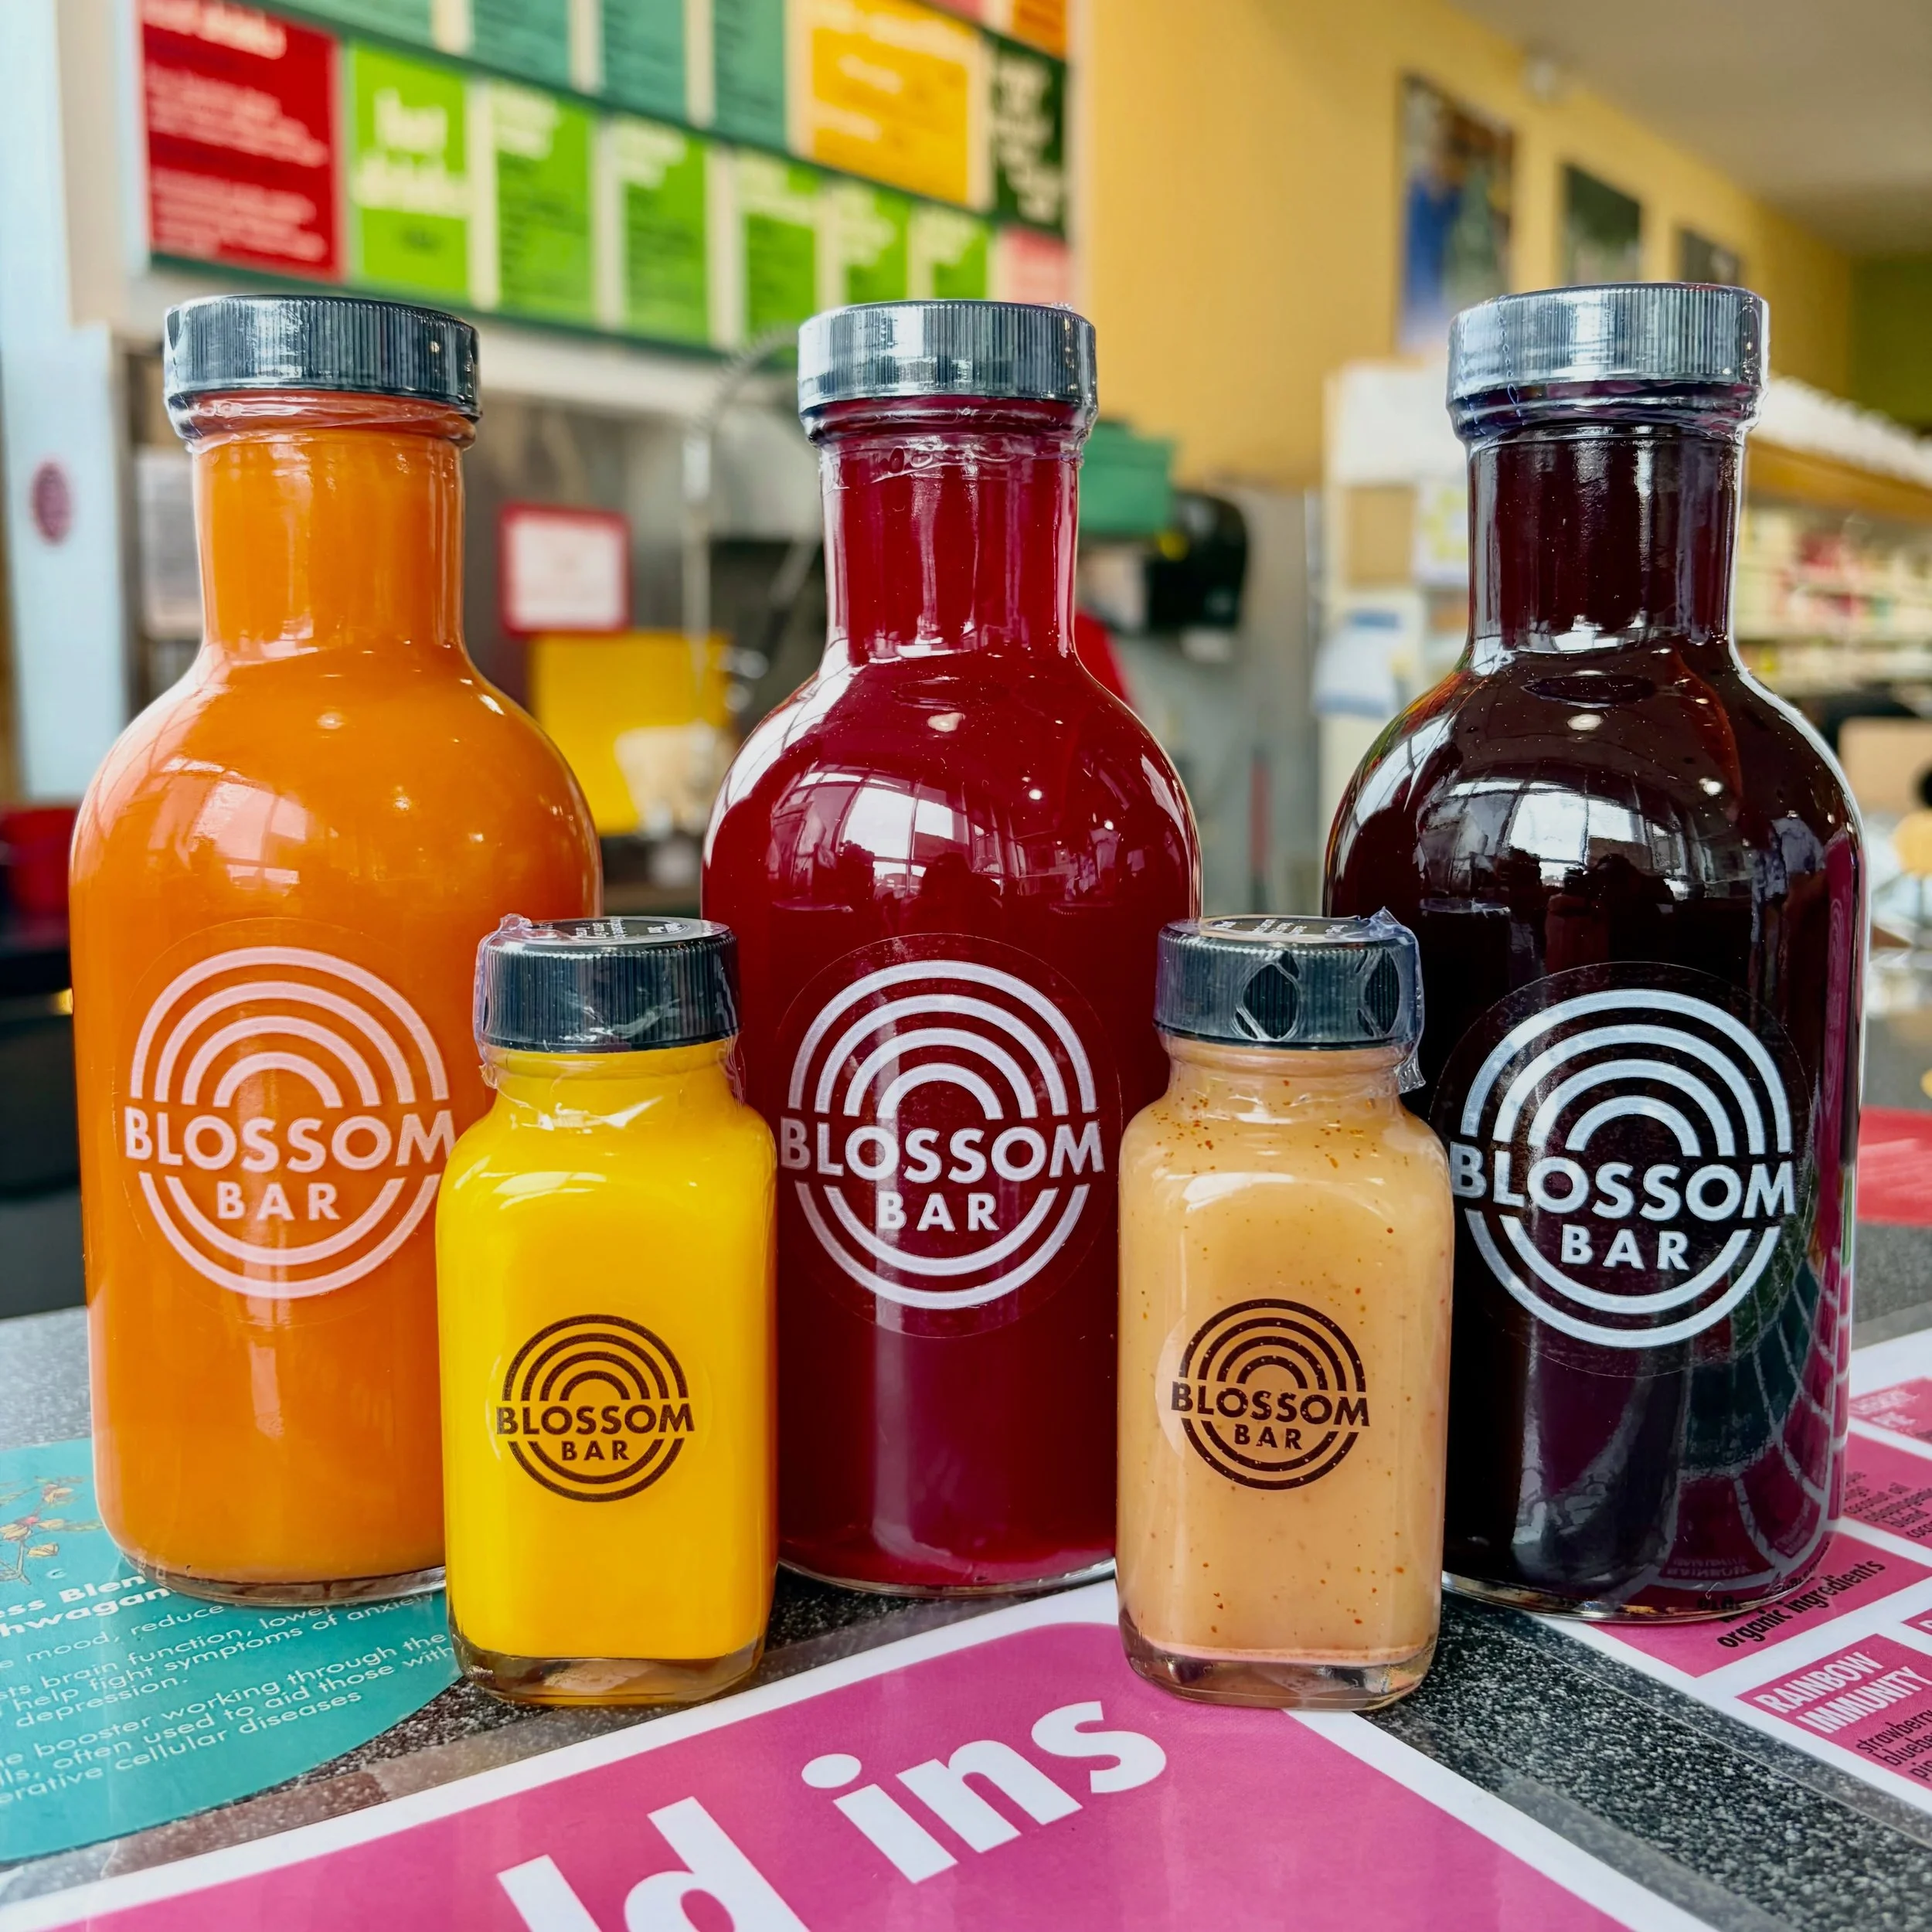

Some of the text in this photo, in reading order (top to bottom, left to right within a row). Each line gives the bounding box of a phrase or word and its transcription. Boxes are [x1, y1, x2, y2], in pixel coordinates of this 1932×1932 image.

[124, 1106, 455, 1173] BLOSSOM
[781, 1117, 1104, 1183] BLOSSOM
[217, 1181, 341, 1221] BAR
[878, 1191, 999, 1231] BAR
[1450, 1141, 1796, 1221] BLOSSOM
[1561, 1223, 1690, 1270] BAR
[496, 1403, 695, 1435] BLOSSOM
[1171, 1381, 1370, 1427] BLOSSOM
[562, 1440, 630, 1461] BAR
[1234, 1423, 1302, 1450] BAR
[0, 1587, 171, 1638] hwagan
[59, 1576, 146, 1604] Blen
[1717, 1608, 1793, 1648] organic
[1775, 1560, 1886, 1614] ingredients
[12, 1689, 79, 1712] help
[90, 1666, 154, 1692] fight
[165, 1628, 303, 1671] symptoms
[311, 1613, 338, 1631] of
[26, 1604, 225, 1662] mood, reduce
[40, 1662, 117, 1689] brain
[128, 1628, 253, 1665] function,
[15, 1675, 189, 1727] depression.
[33, 1632, 447, 1758] booster working through the
[53, 1741, 131, 1769] often
[143, 1713, 216, 1743] used
[223, 1706, 255, 1721] to
[265, 1685, 310, 1709] aid
[318, 1665, 396, 1692] those
[402, 1645, 454, 1668] with
[1753, 1651, 1884, 1713] RAINBOW
[1796, 1665, 1932, 1734] IMMUNITY
[114, 1730, 228, 1770] cellular
[238, 1690, 362, 1733] diseases
[801, 1701, 1167, 1884] ins
